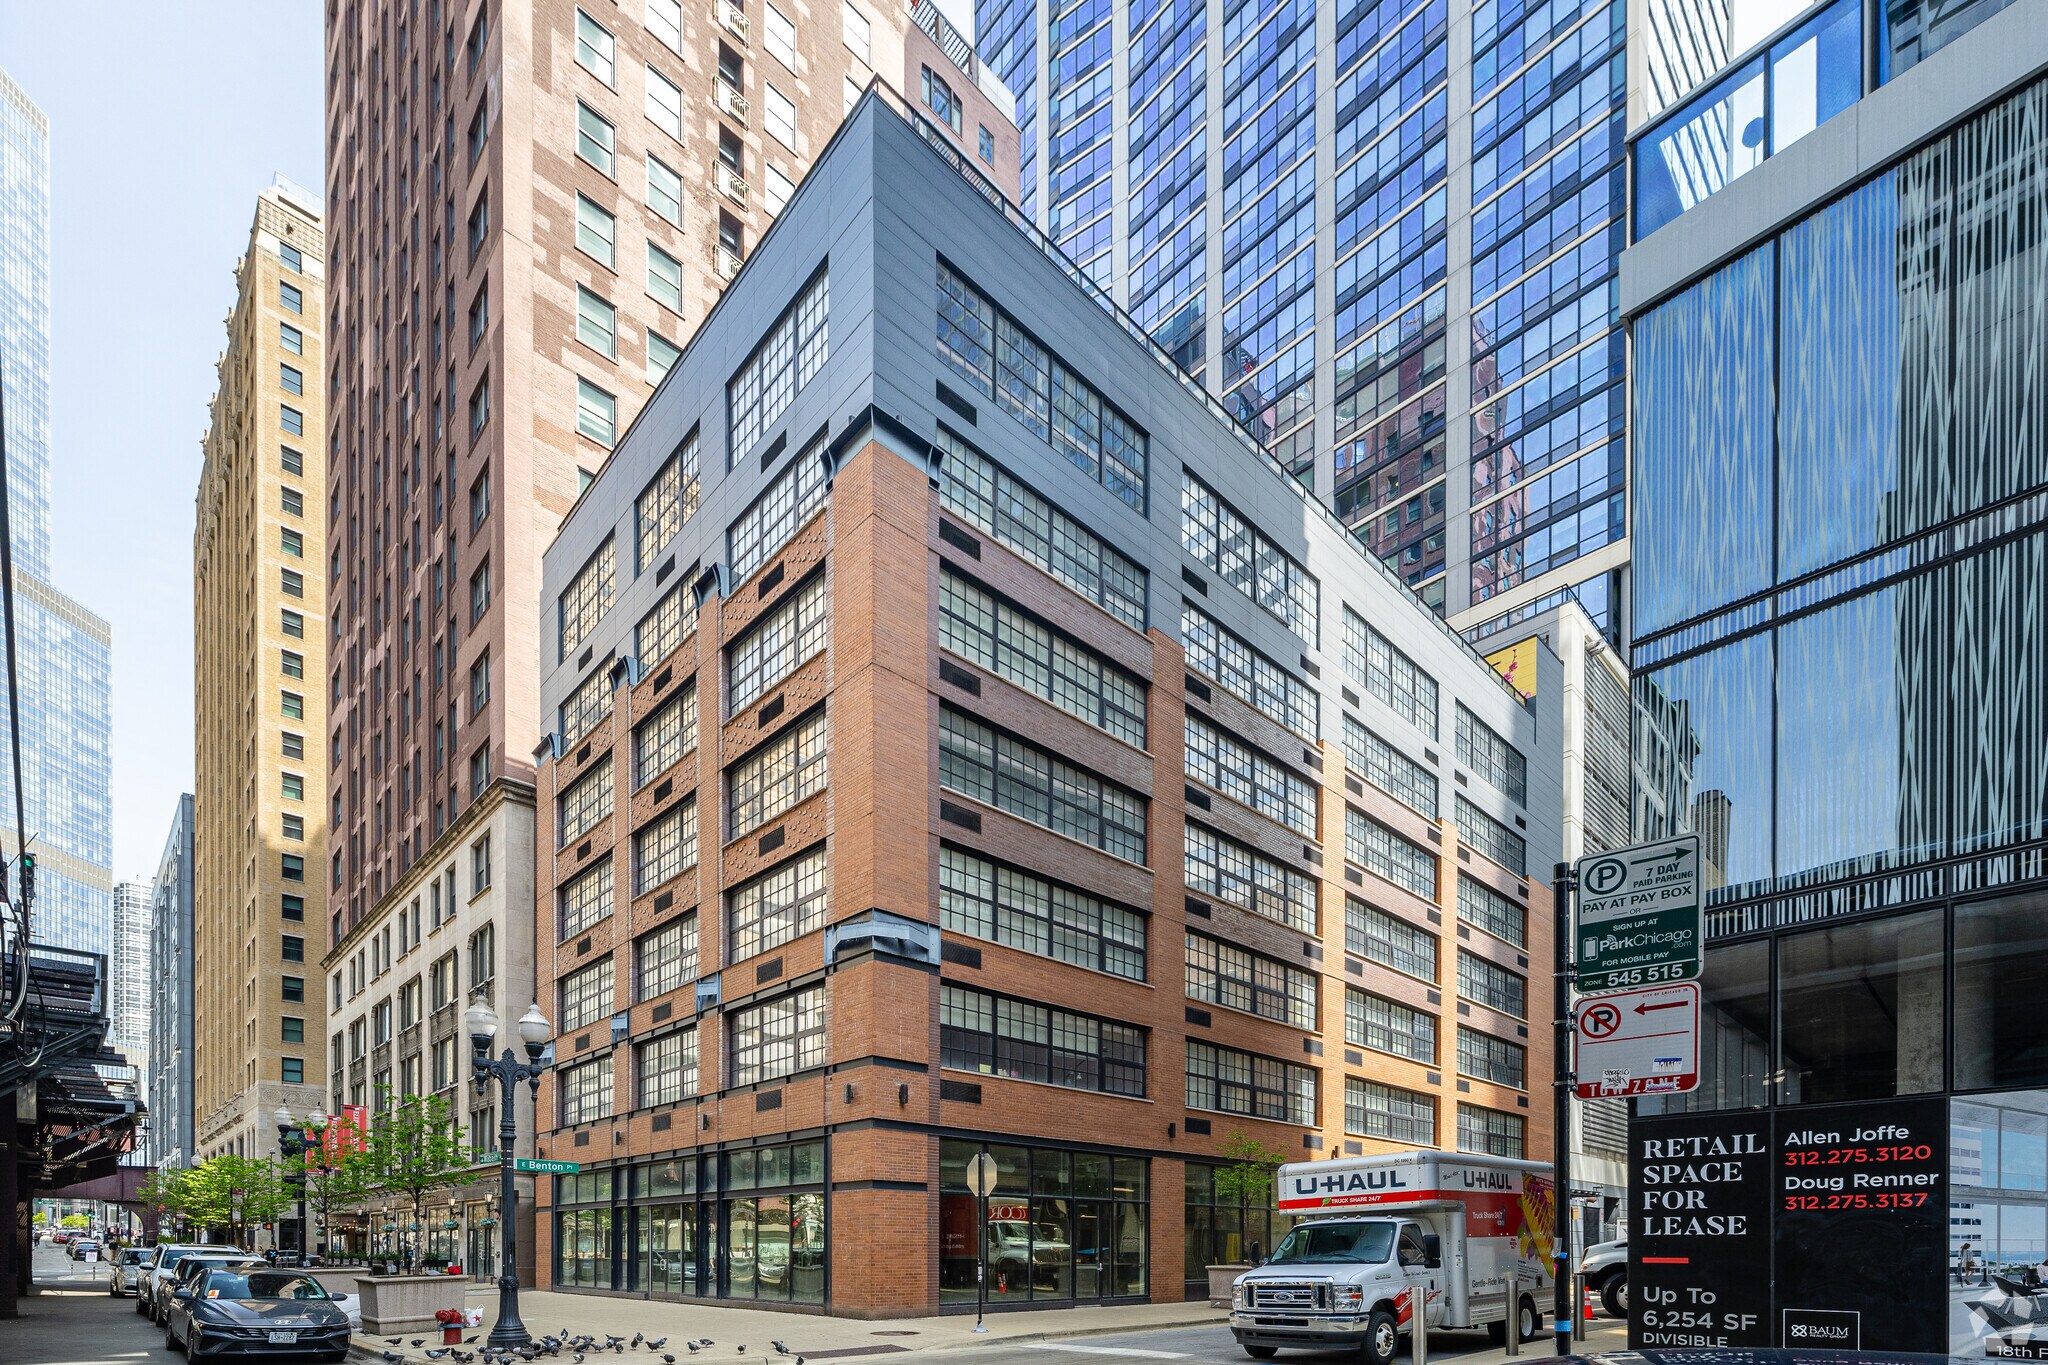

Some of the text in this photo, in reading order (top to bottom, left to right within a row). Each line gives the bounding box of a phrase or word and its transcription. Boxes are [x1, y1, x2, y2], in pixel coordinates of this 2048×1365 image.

[1633, 870, 1694, 888] PAID PARKING
[1646, 862, 1681, 878] 7 DAY
[1582, 885, 1692, 914] PAY AT PAY BOX
[1629, 907, 1641, 915] OR
[1612, 922, 1633, 932] SIGN
[1634, 920, 1646, 928] UP
[1599, 929, 1692, 952] ParkChicago
[1671, 940, 1692, 949] .com
[1602, 951, 1670, 967] FOR MOBILE PAY
[1584, 963, 1684, 987] ZONE 545 515
[1784, 1125, 1910, 1146] Allen Joffe
[1643, 1133, 1766, 1159] RETAIL
[1785, 1145, 1932, 1166] 312.275.3120
[529, 1160, 563, 1171] Benton
[1643, 1161, 1743, 1185] SPACE
[1295, 1170, 1406, 1195] U-HAUL
[1463, 1170, 1512, 1190] U-HAUL
[1785, 1173, 1939, 1191] Doug Renner
[1331, 1195, 1381, 1205] TRUCK SHARE 24/7
[1643, 1189, 1708, 1210] FOR
[1785, 1193, 1928, 1210] 312.275.3137
[1643, 1215, 1747, 1236] LEASE
[1643, 1286, 1717, 1306] Up To
[1643, 1309, 1758, 1331] 6,254 SF
[1643, 1332, 1728, 1348] DIVISIBLE
[1809, 1325, 1849, 1336] BAUM
[1995, 1345, 2032, 1358] 18th
